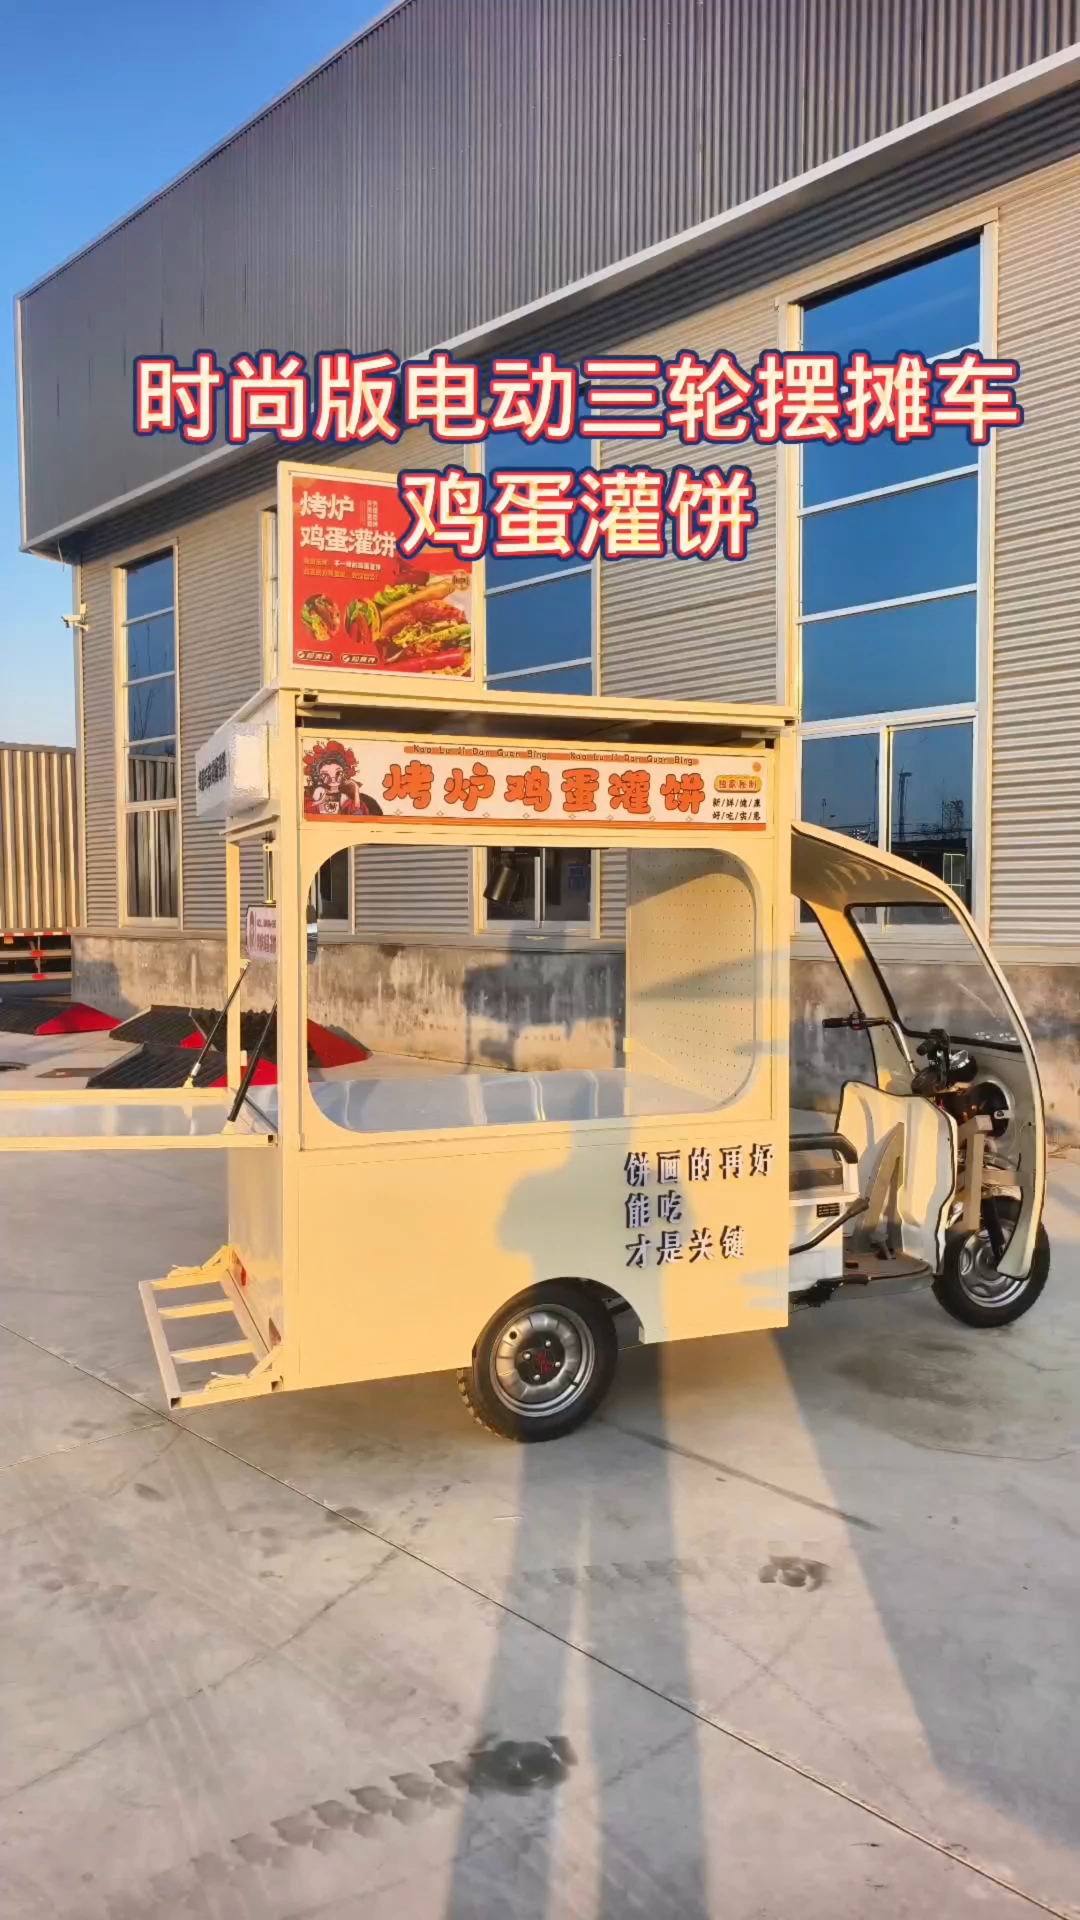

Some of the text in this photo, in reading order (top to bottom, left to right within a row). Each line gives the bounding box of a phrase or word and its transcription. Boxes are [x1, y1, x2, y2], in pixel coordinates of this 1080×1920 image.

[300, 491, 355, 521] 烤炉
[300, 524, 396, 558] 鸡蛋灌饼
[413, 745, 547, 760] Kao Lu Ji Dan Guan Bing
[569, 752, 587, 760] Kao
[593, 753, 604, 761] Lu
[624, 754, 640, 762] Dan
[646, 755, 667, 763] Guan
[674, 756, 692, 766] Bing
[382, 760, 706, 815] 烤炉鸡蛋灌饼
[718, 779, 757, 789] 独家秘制
[624, 1143, 776, 1186] 饼画的再好
[625, 1190, 683, 1228] 能吃
[625, 1225, 745, 1268] 才是关键
